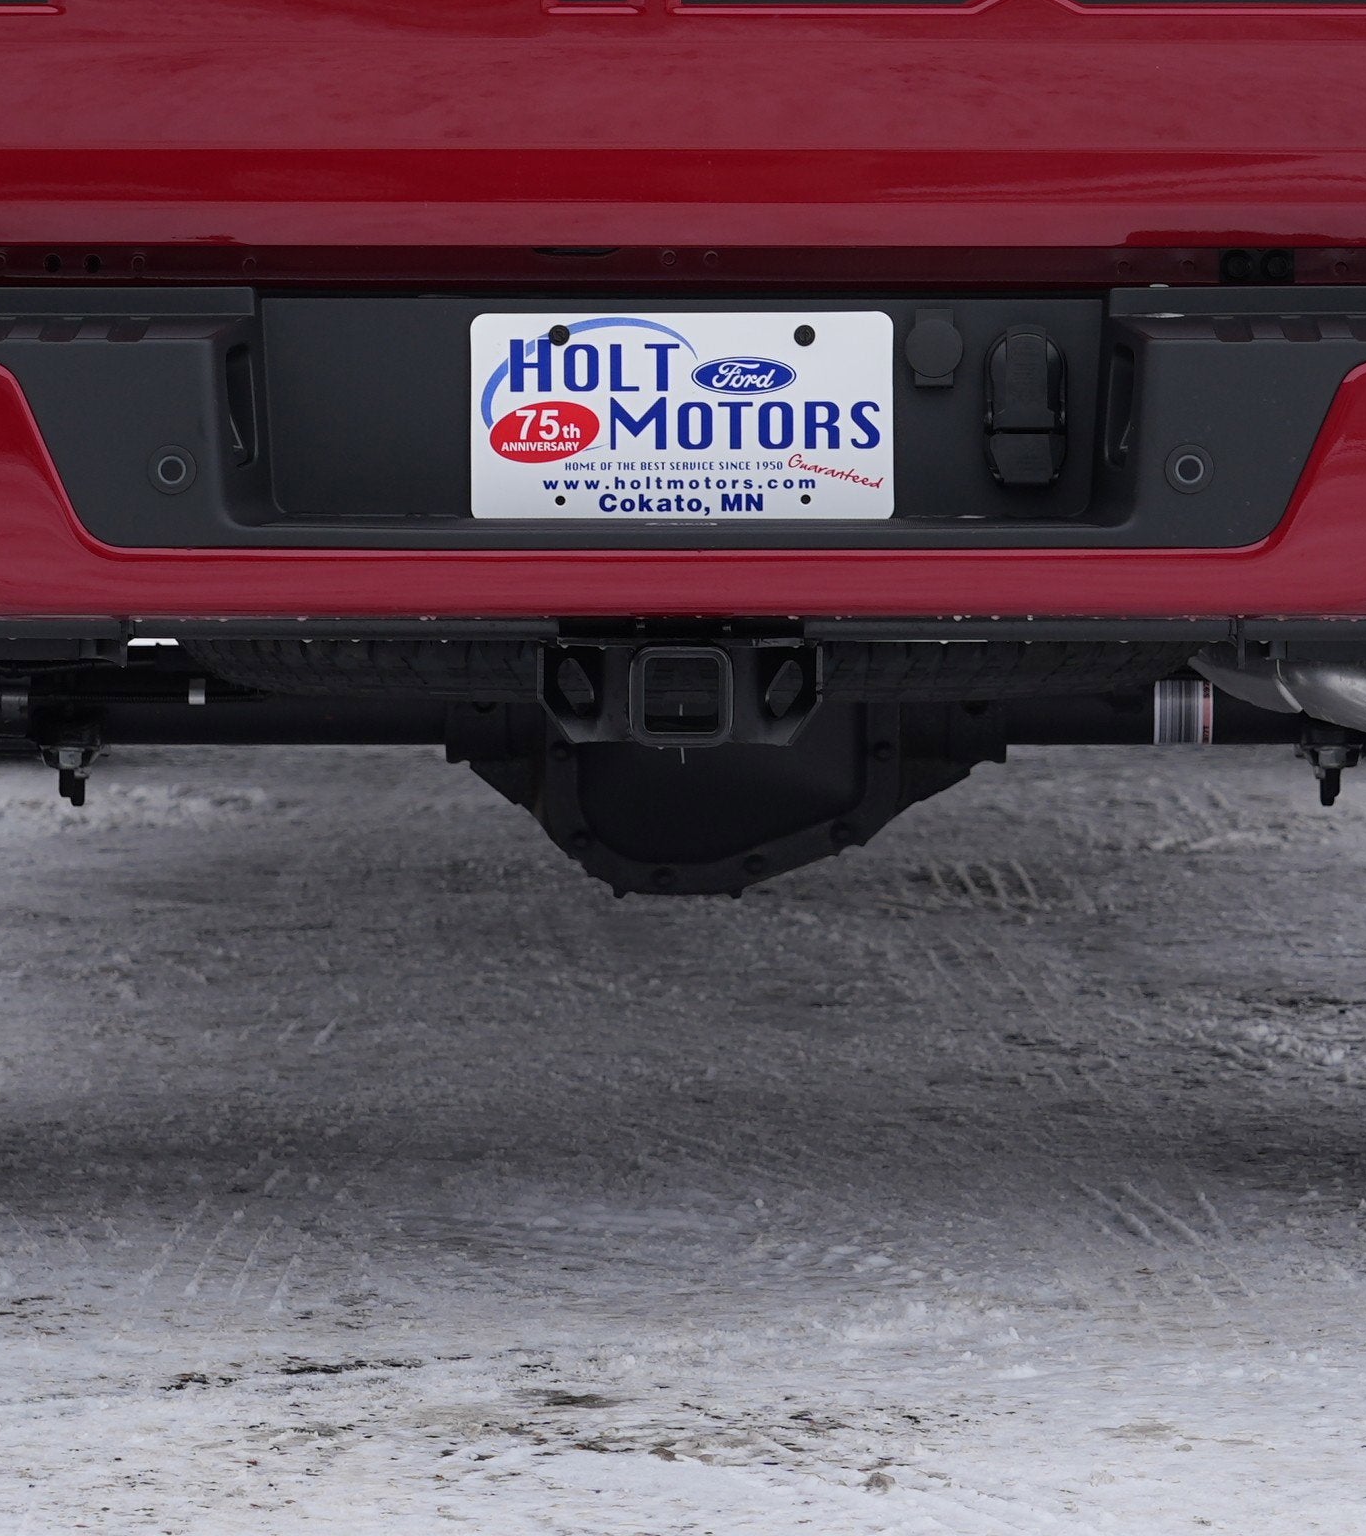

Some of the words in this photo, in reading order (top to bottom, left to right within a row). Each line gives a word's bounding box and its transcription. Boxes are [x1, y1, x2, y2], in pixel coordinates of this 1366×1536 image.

[509, 339, 681, 393] HOLT
[711, 363, 775, 390] Ford
[515, 409, 581, 441] 75th
[610, 396, 881, 451] MOTORS
[501, 441, 580, 452] ANNIVERSARY
[564, 461, 596, 471] HOME
[600, 461, 613, 471] OF
[617, 461, 636, 471] THE
[640, 461, 665, 471] BEST
[669, 461, 714, 471] SERVICE
[718, 461, 751, 471] SINCE
[756, 461, 783, 471] 1950
[787, 453, 884, 490] Guaranteed
[542, 476, 816, 490] www.holtmotors.com
[598, 493, 711, 516] Cokato,
[721, 493, 764, 512] MN
